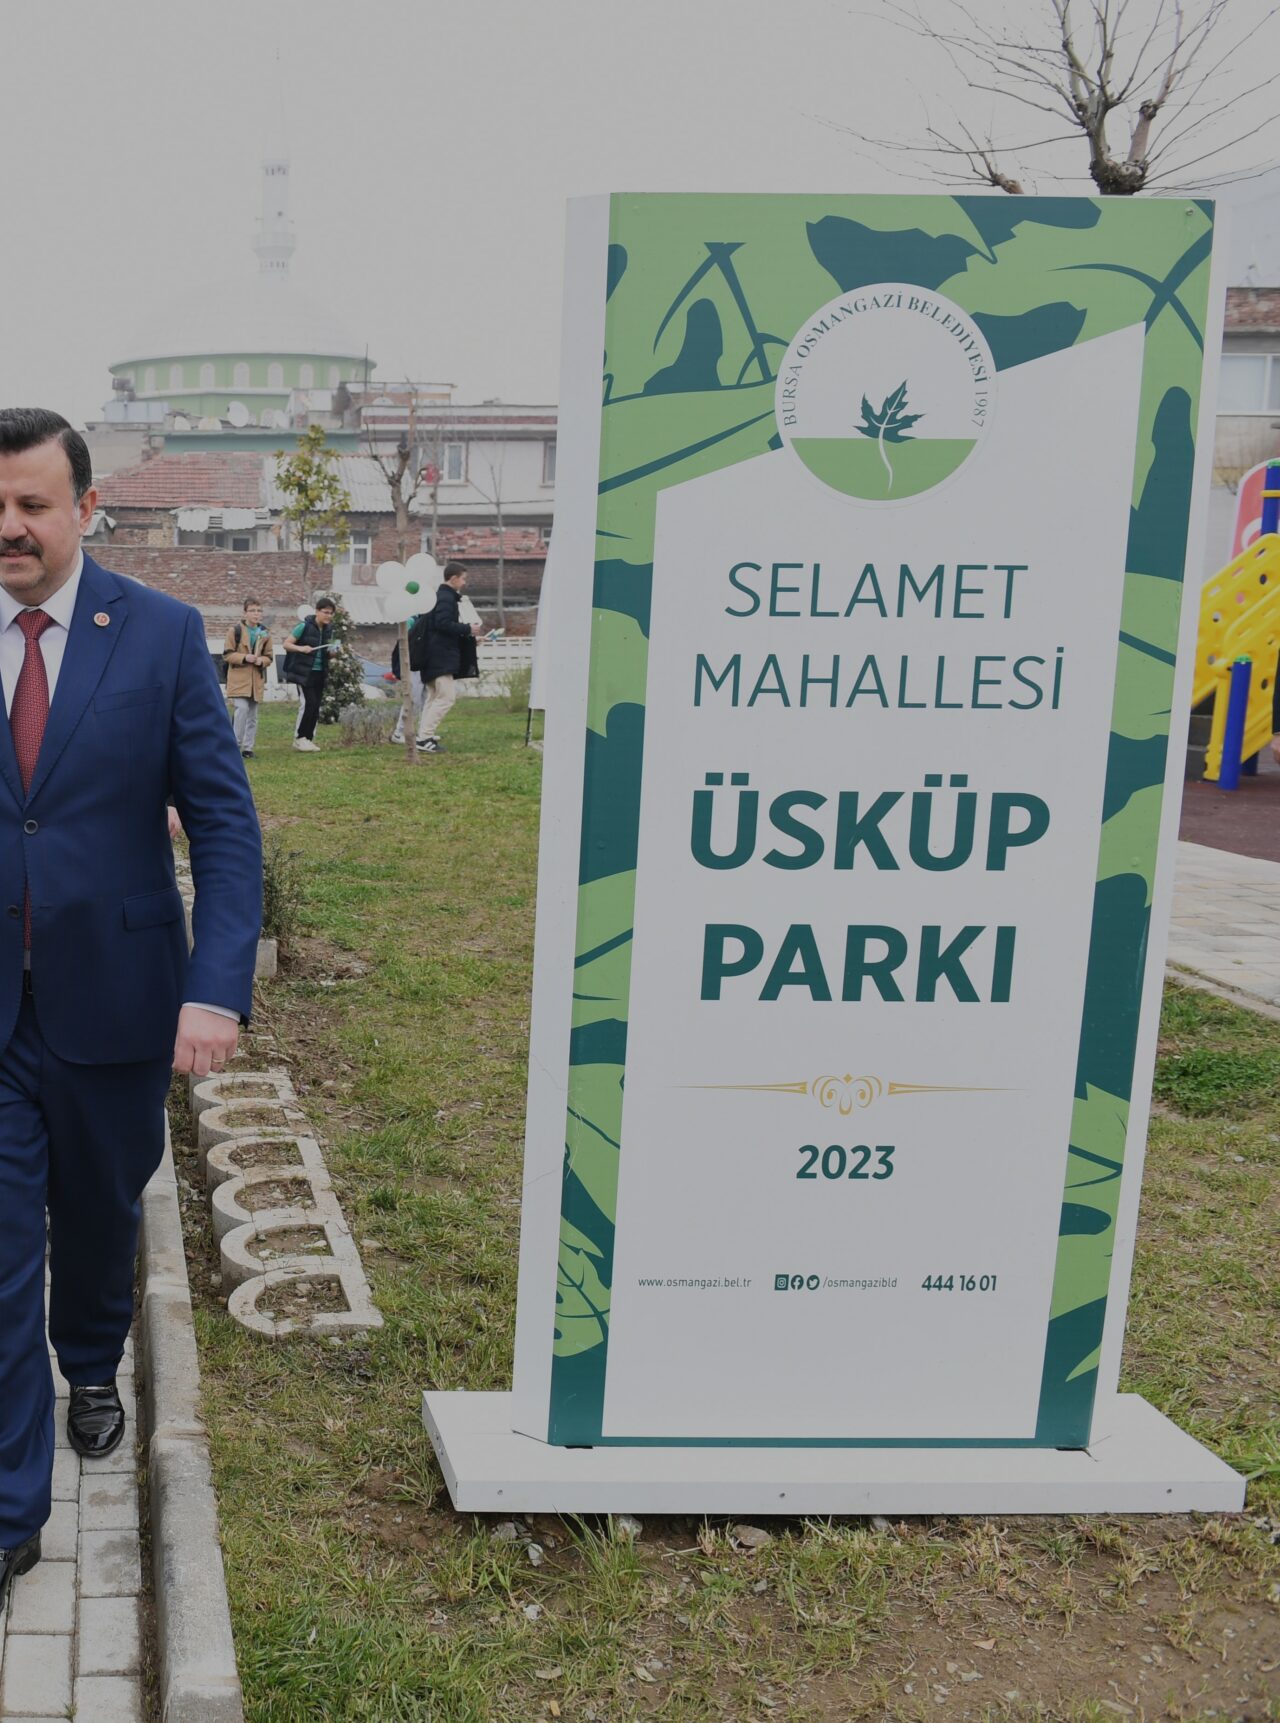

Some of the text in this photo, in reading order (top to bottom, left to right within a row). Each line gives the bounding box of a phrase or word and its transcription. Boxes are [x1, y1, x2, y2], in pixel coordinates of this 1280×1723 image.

[782, 291, 992, 428] BURSA OSMANGAZİ BELEDİYESİ 1987
[725, 562, 1028, 618] SELAMET
[694, 647, 1064, 710] MAHALLESİ
[691, 772, 1050, 871] ÜSKÜP
[700, 923, 1017, 1002] PARKI
[796, 1144, 896, 1180] 2023
[638, 1277, 752, 1290] www.osmangazi.bel.tr
[921, 1275, 954, 1292] 444
